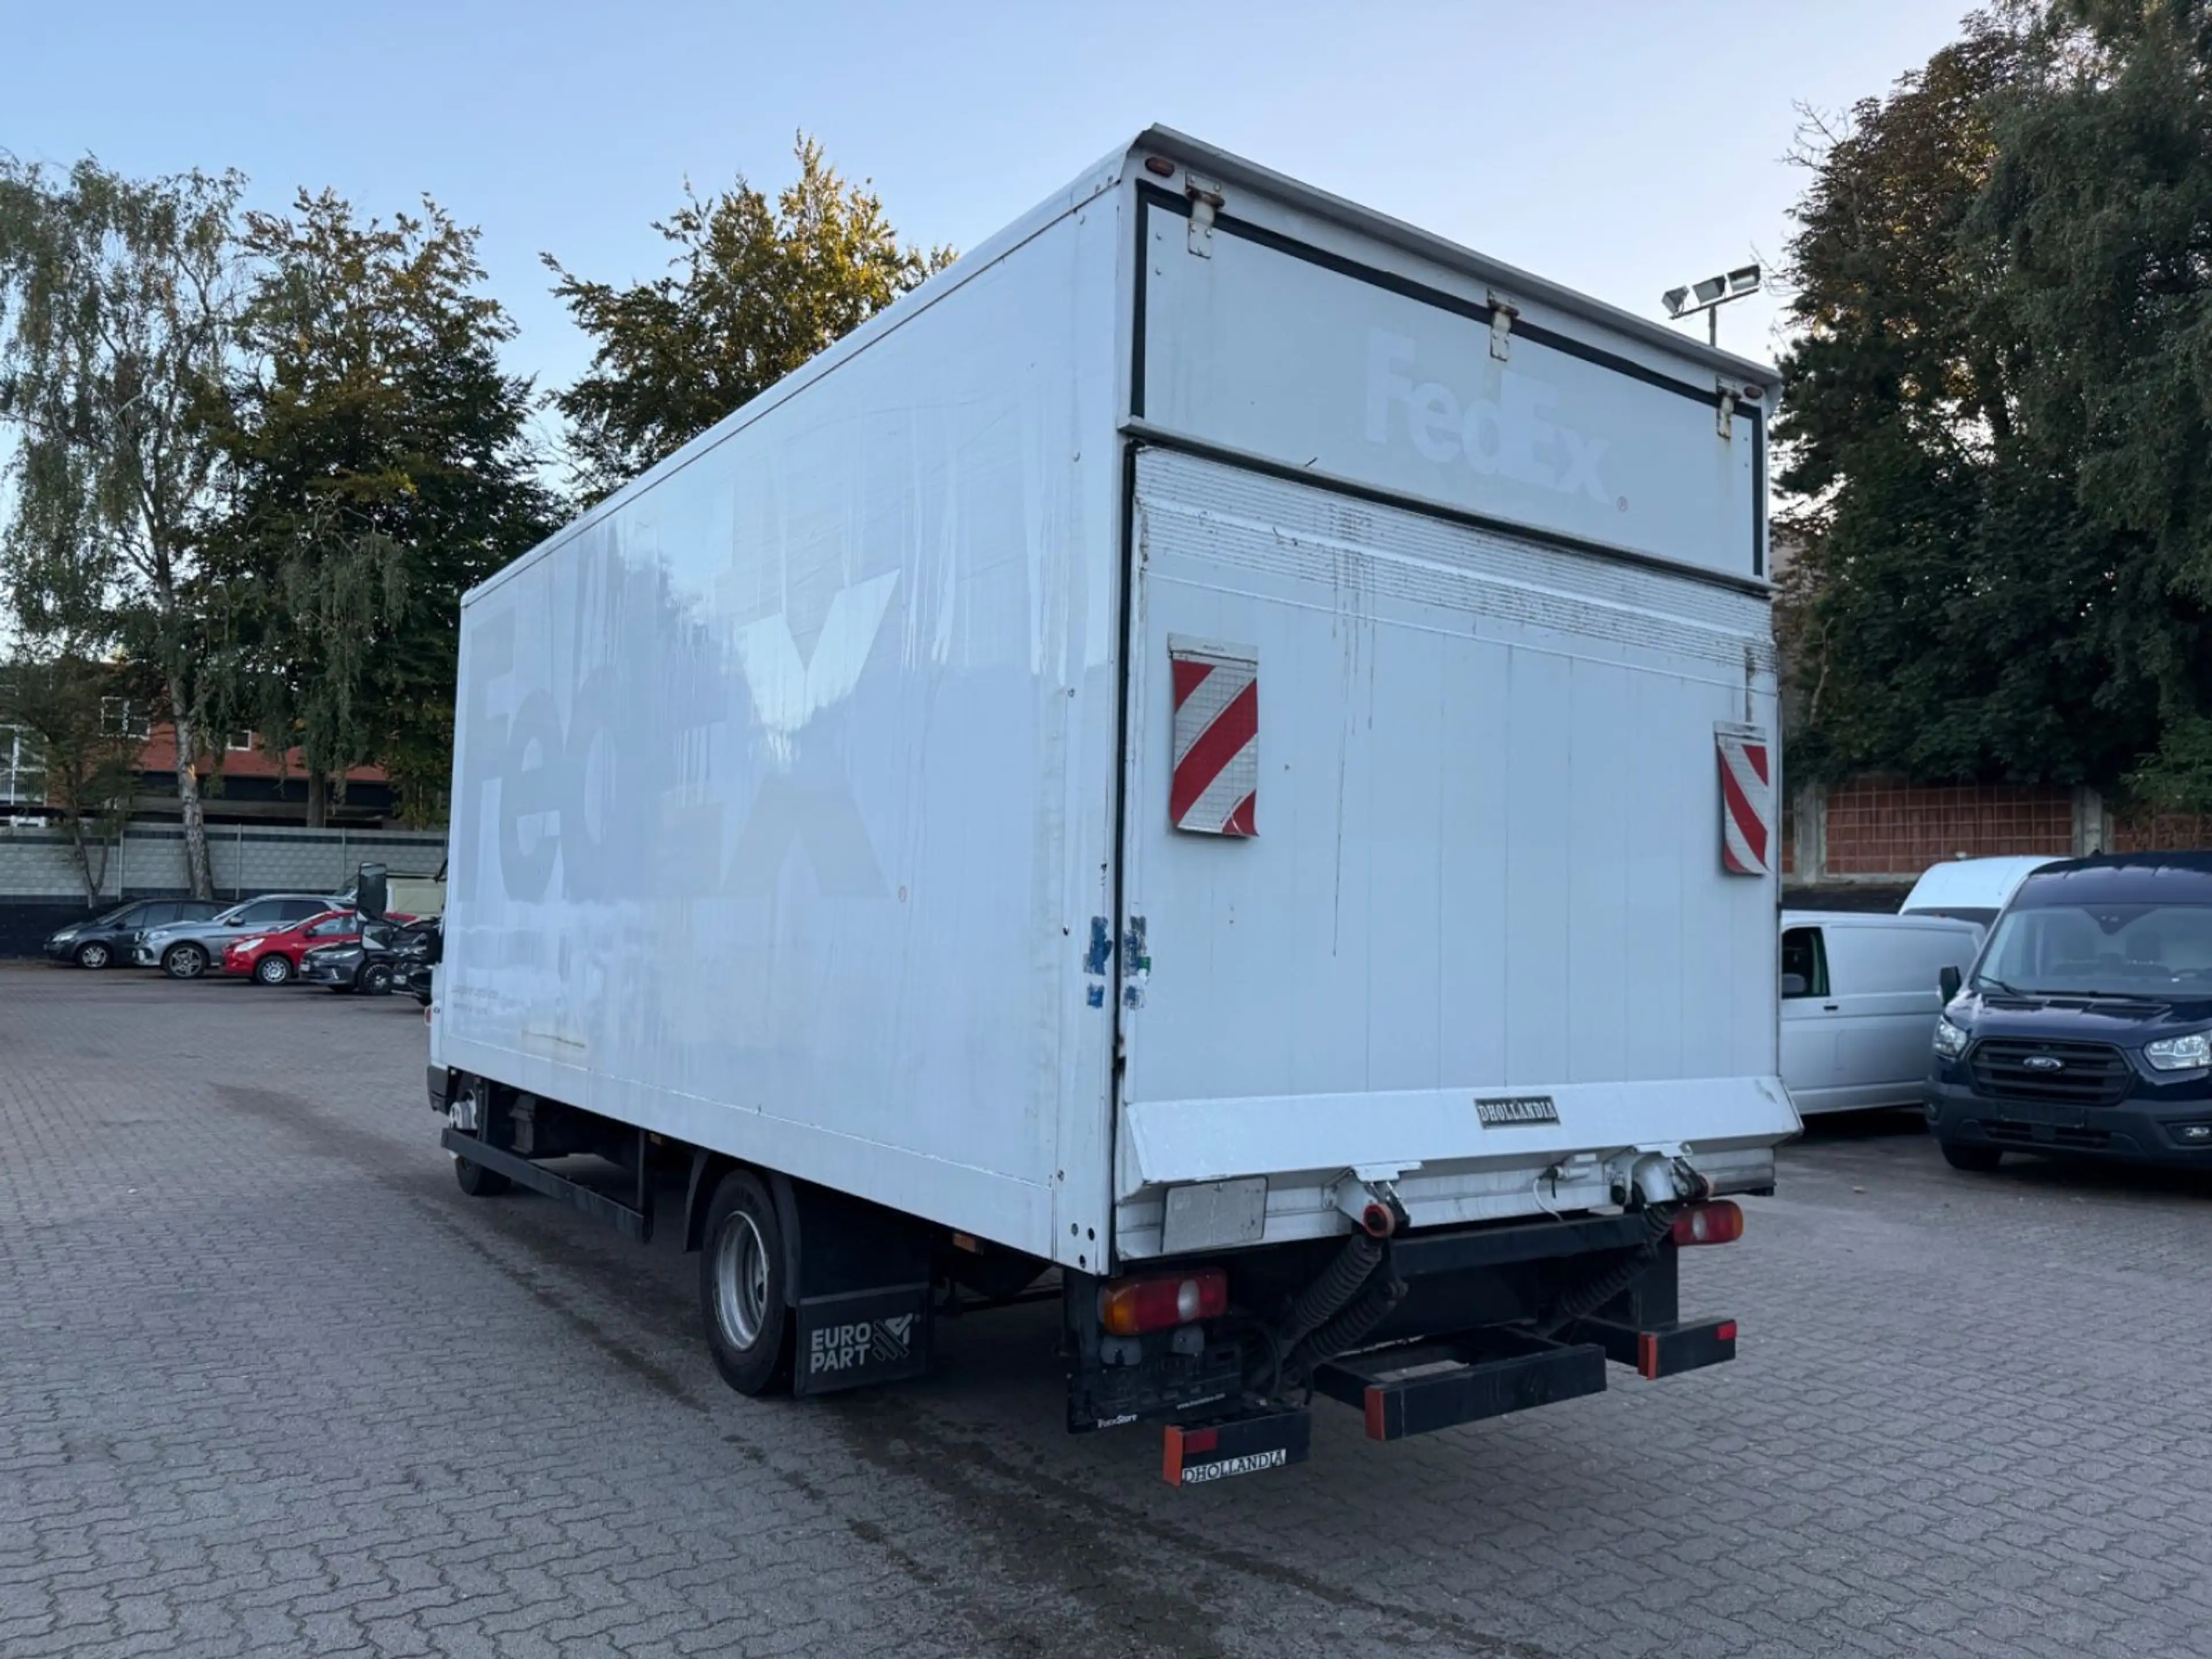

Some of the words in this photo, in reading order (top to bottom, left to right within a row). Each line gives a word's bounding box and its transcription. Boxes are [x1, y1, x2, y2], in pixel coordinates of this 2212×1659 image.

[1364, 327, 1615, 506] FedEx
[1478, 1101, 1556, 1121] DHOLLANDIA
[811, 1323, 872, 1351] EURO
[810, 1343, 871, 1374] PART
[1183, 1449, 1286, 1482] DHOLLANDIA
